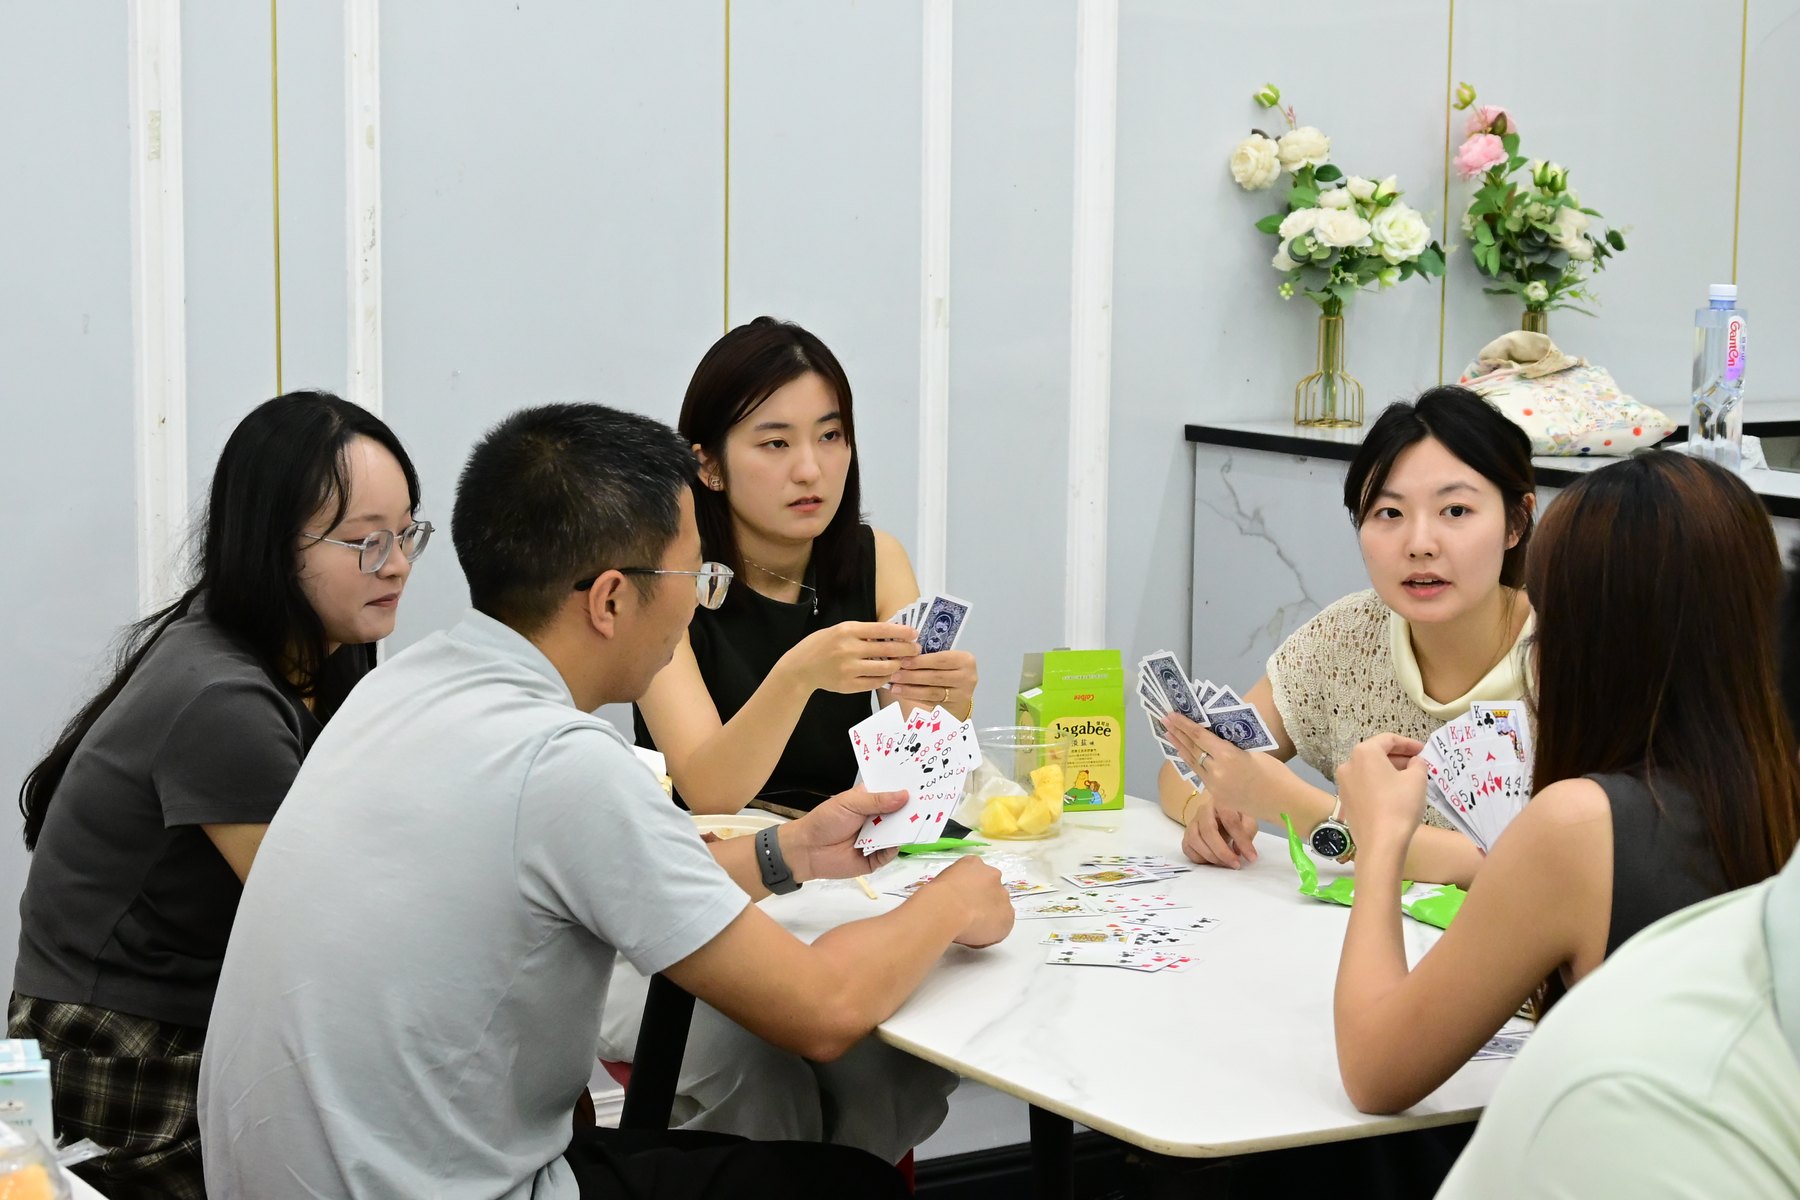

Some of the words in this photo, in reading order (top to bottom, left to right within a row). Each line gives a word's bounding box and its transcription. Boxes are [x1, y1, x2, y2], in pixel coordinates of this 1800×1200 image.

[910, 712, 920, 723] J
[1474, 705, 1482, 718] K
[853, 730, 860, 740] A
[947, 731, 957, 741] 8
[1054, 721, 1111, 739] Jagabee
[1450, 726, 1458, 739] K
[1465, 726, 1473, 739] K
[876, 733, 883, 745] K
[897, 734, 906, 745] J
[934, 739, 944, 748] 8
[1436, 735, 1446, 749] A
[863, 744, 870, 755] A
[920, 746, 930, 756] 8
[1454, 748, 1464, 762] 3
[1443, 768, 1453, 782] 2
[1471, 774, 1480, 788] 5
[1487, 771, 1494, 784] 4
[1438, 777, 1449, 791] 2
[1505, 776, 1511, 789] 4
[1515, 776, 1521, 789] 4
[1450, 794, 1461, 807] 6
[1458, 789, 1468, 803] 5
